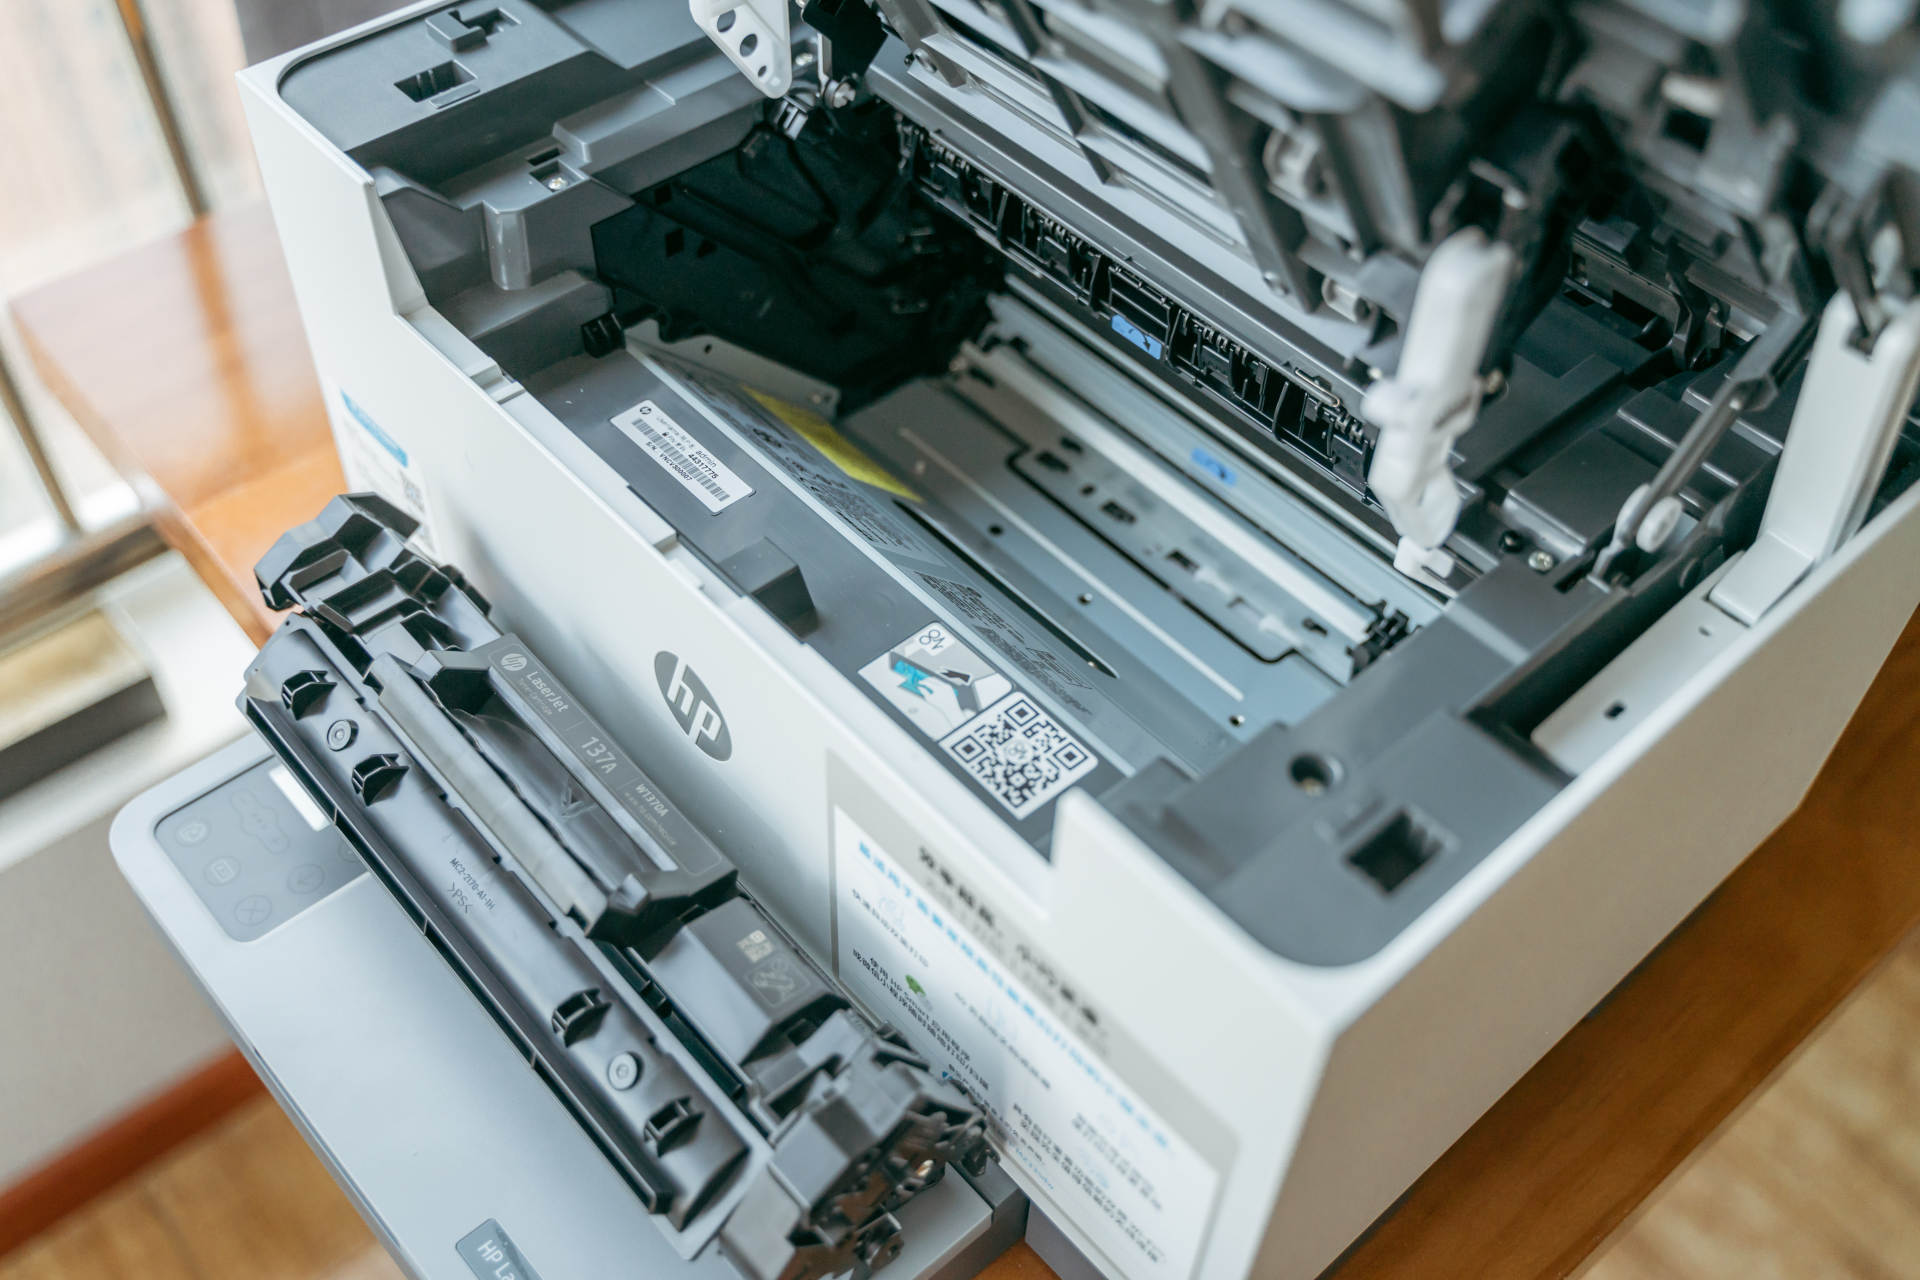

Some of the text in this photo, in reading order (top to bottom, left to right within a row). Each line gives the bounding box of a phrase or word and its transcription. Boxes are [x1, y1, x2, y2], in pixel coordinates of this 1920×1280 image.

[688, 454, 719, 479] 44317775
[696, 450, 717, 468] admin
[501, 653, 527, 671] hp
[526, 671, 569, 712] LaserJet
[660, 652, 729, 757] hp
[581, 736, 618, 774] 137A
[635, 783, 669, 817] W1370A
[477, 1239, 504, 1263] HP
